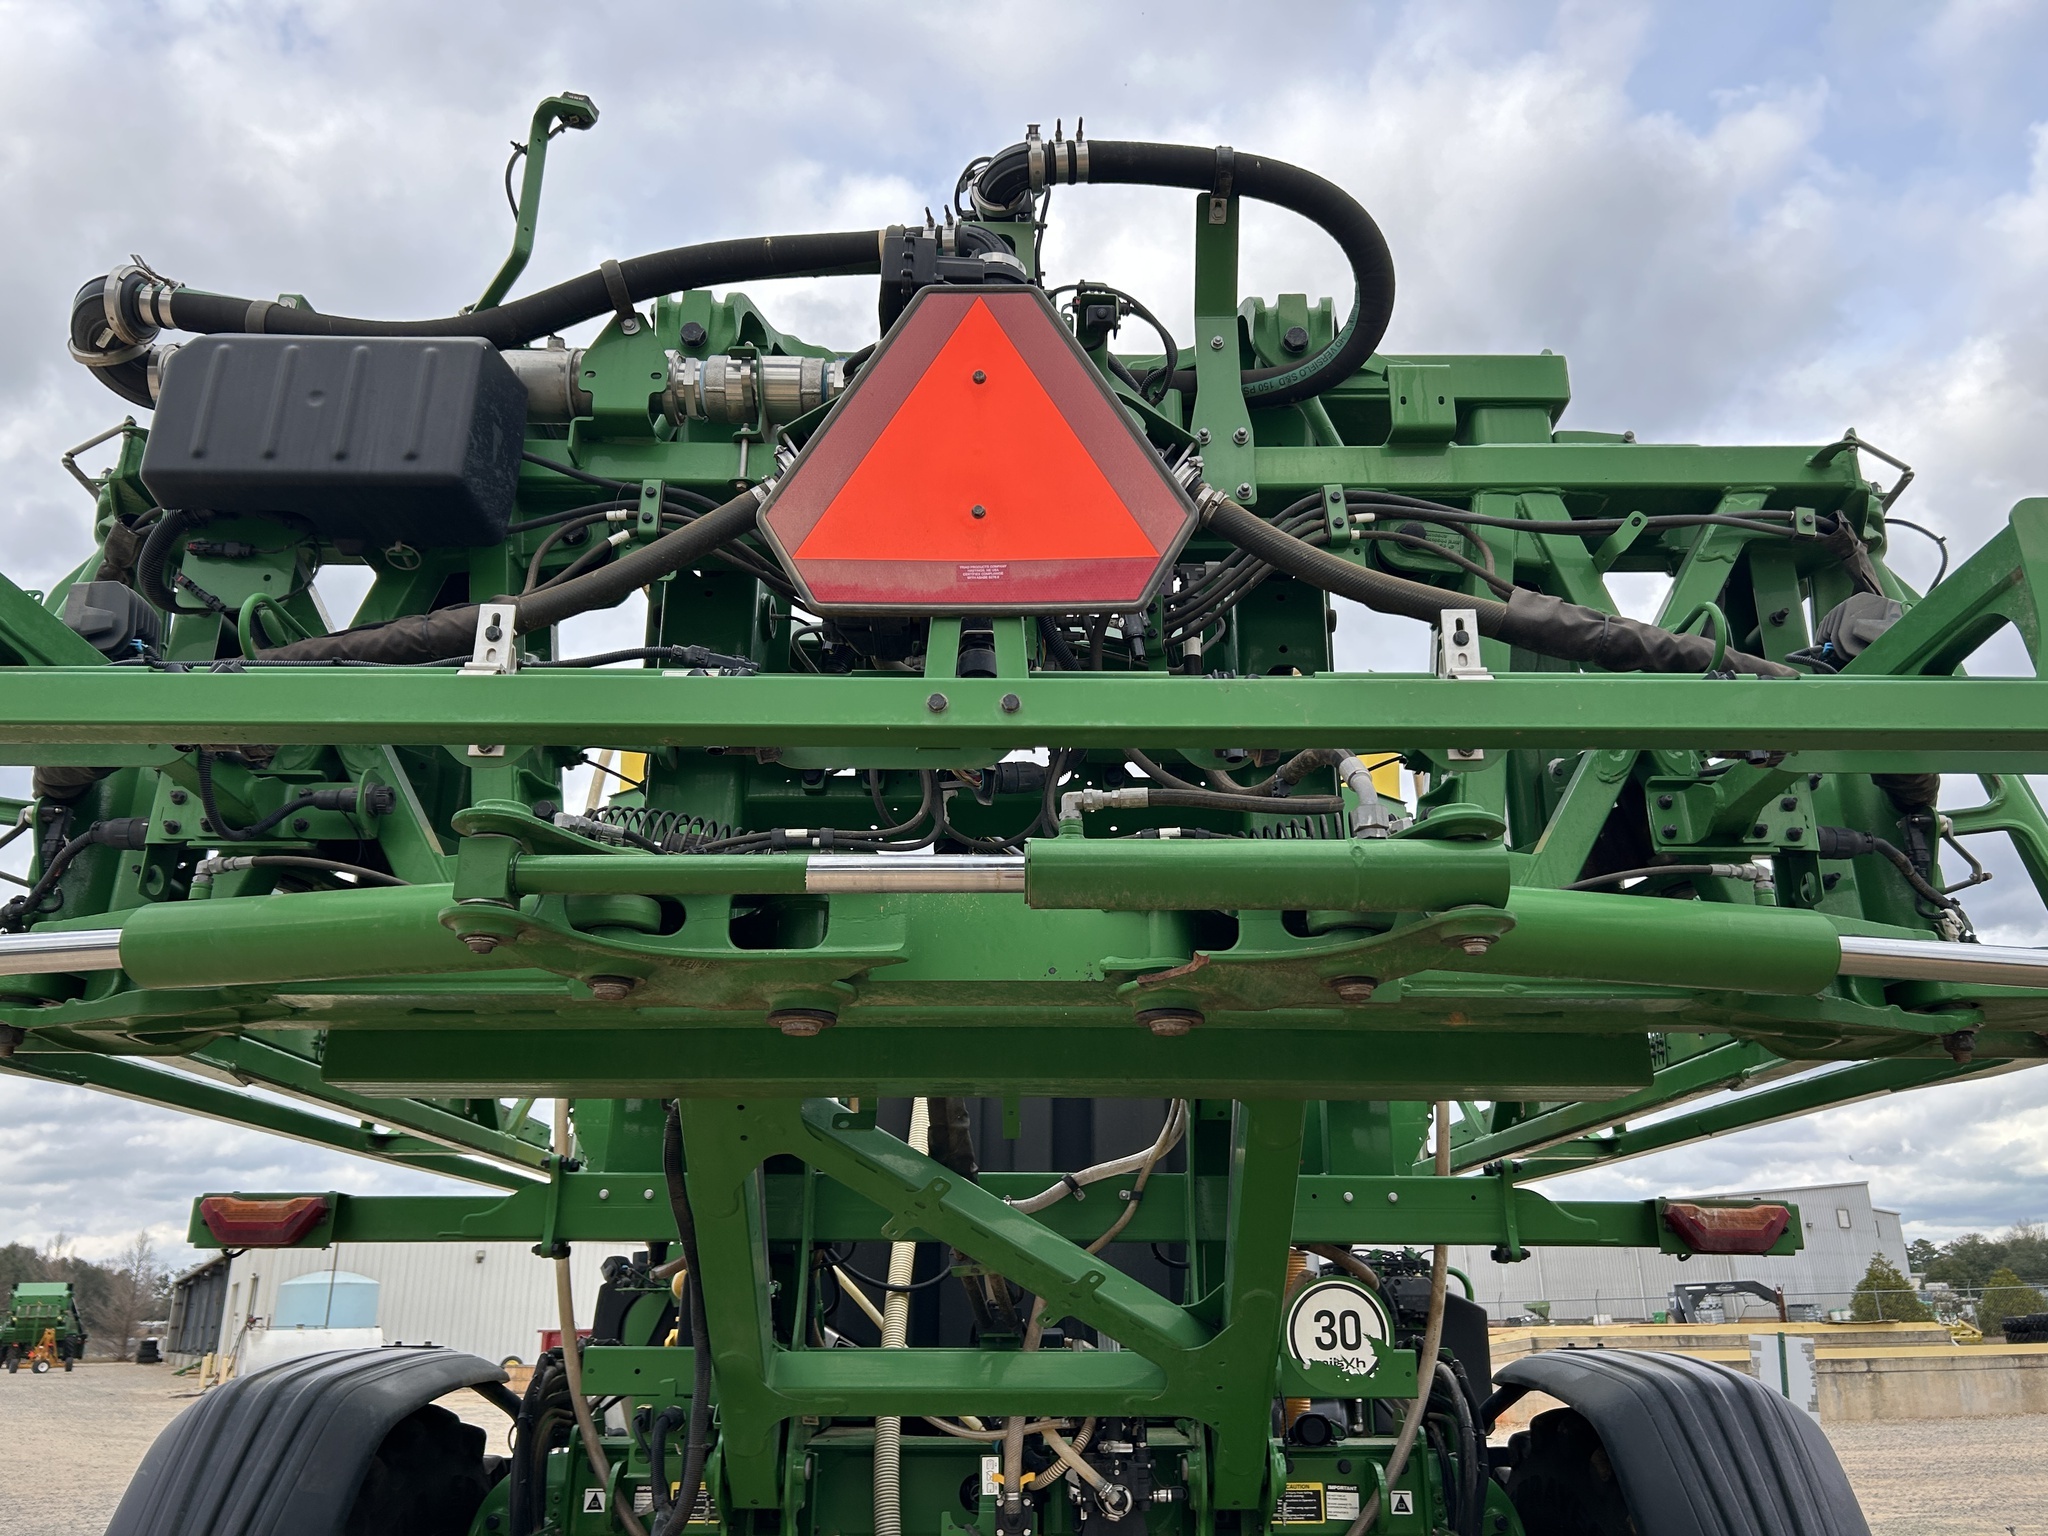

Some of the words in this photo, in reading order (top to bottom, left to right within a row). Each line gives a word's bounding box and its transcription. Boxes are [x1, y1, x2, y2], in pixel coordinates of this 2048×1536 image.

[1335, 337, 1346, 348] HD
[1299, 349, 1338, 377] VERSIFLO
[1278, 372, 1298, 386] S&D
[1258, 382, 1274, 392] 150
[1313, 1309, 1362, 1351] 30
